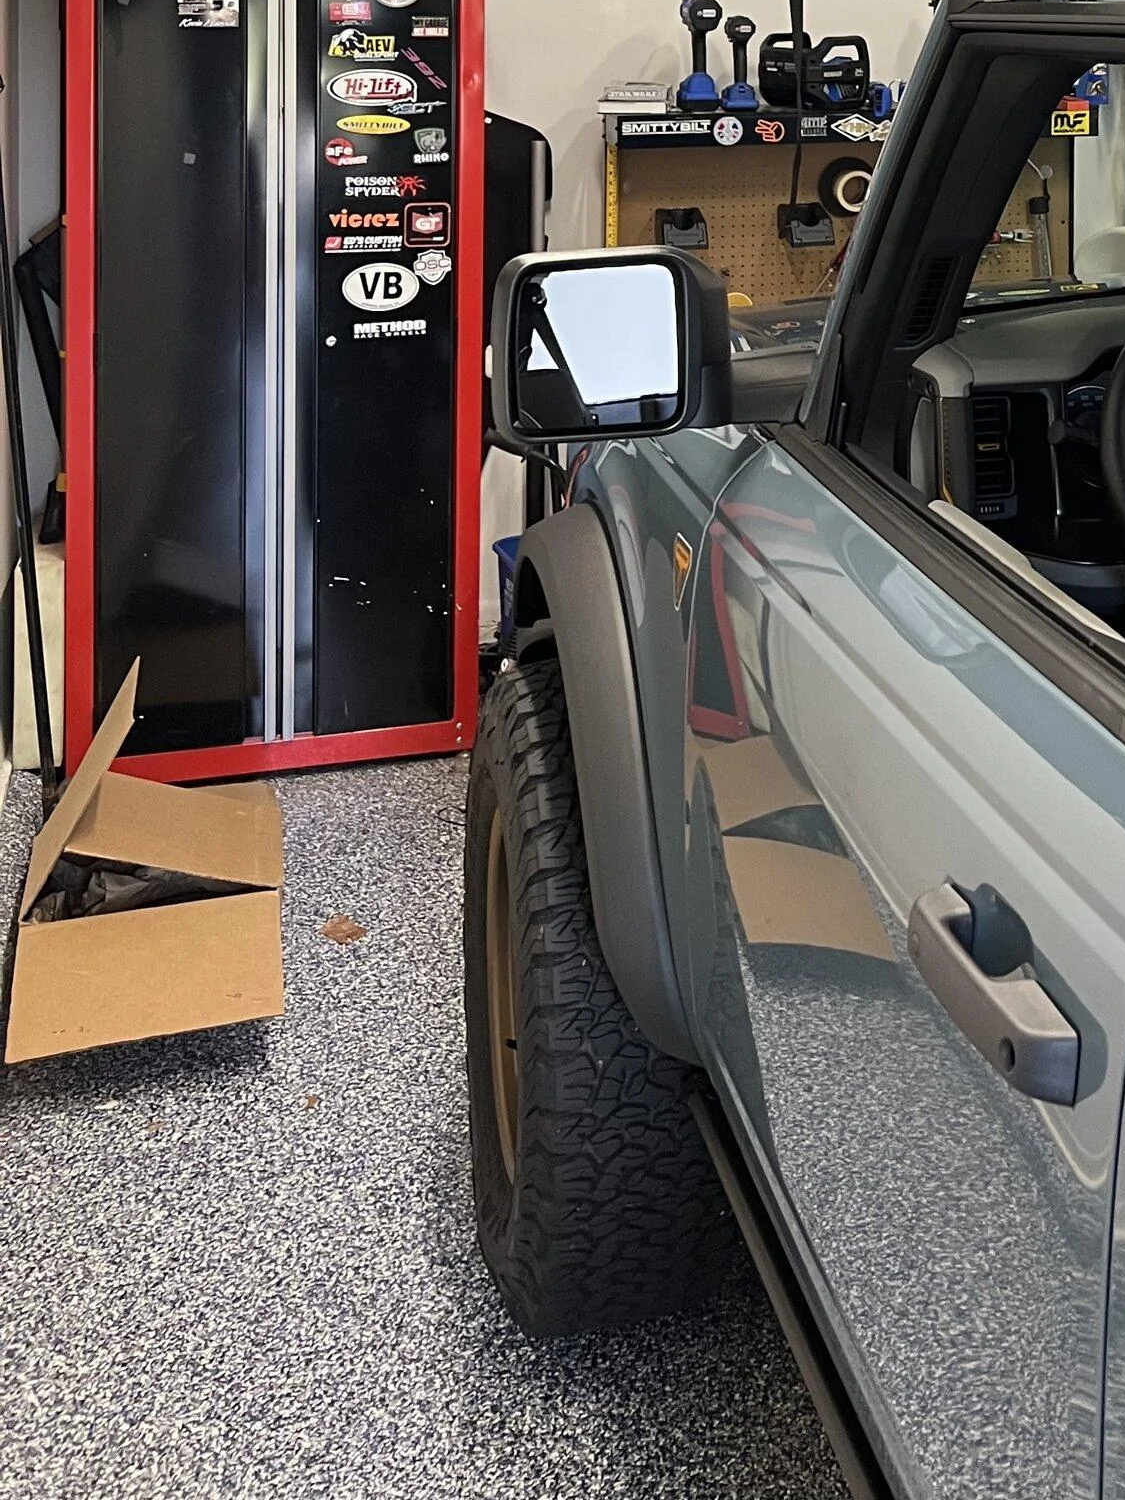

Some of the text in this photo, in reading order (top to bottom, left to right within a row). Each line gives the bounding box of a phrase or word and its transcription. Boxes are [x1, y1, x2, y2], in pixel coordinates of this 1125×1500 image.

[366, 38, 391, 53] AEV
[343, 78, 402, 96] Hi-Lift
[621, 121, 711, 134] SMITTYBILT
[413, 152, 450, 164] RHINO
[344, 176, 398, 187] POISON
[344, 186, 401, 198] SPYDER
[328, 208, 400, 228] vicrez
[358, 271, 403, 300] VB
[353, 319, 427, 334] METHOD
